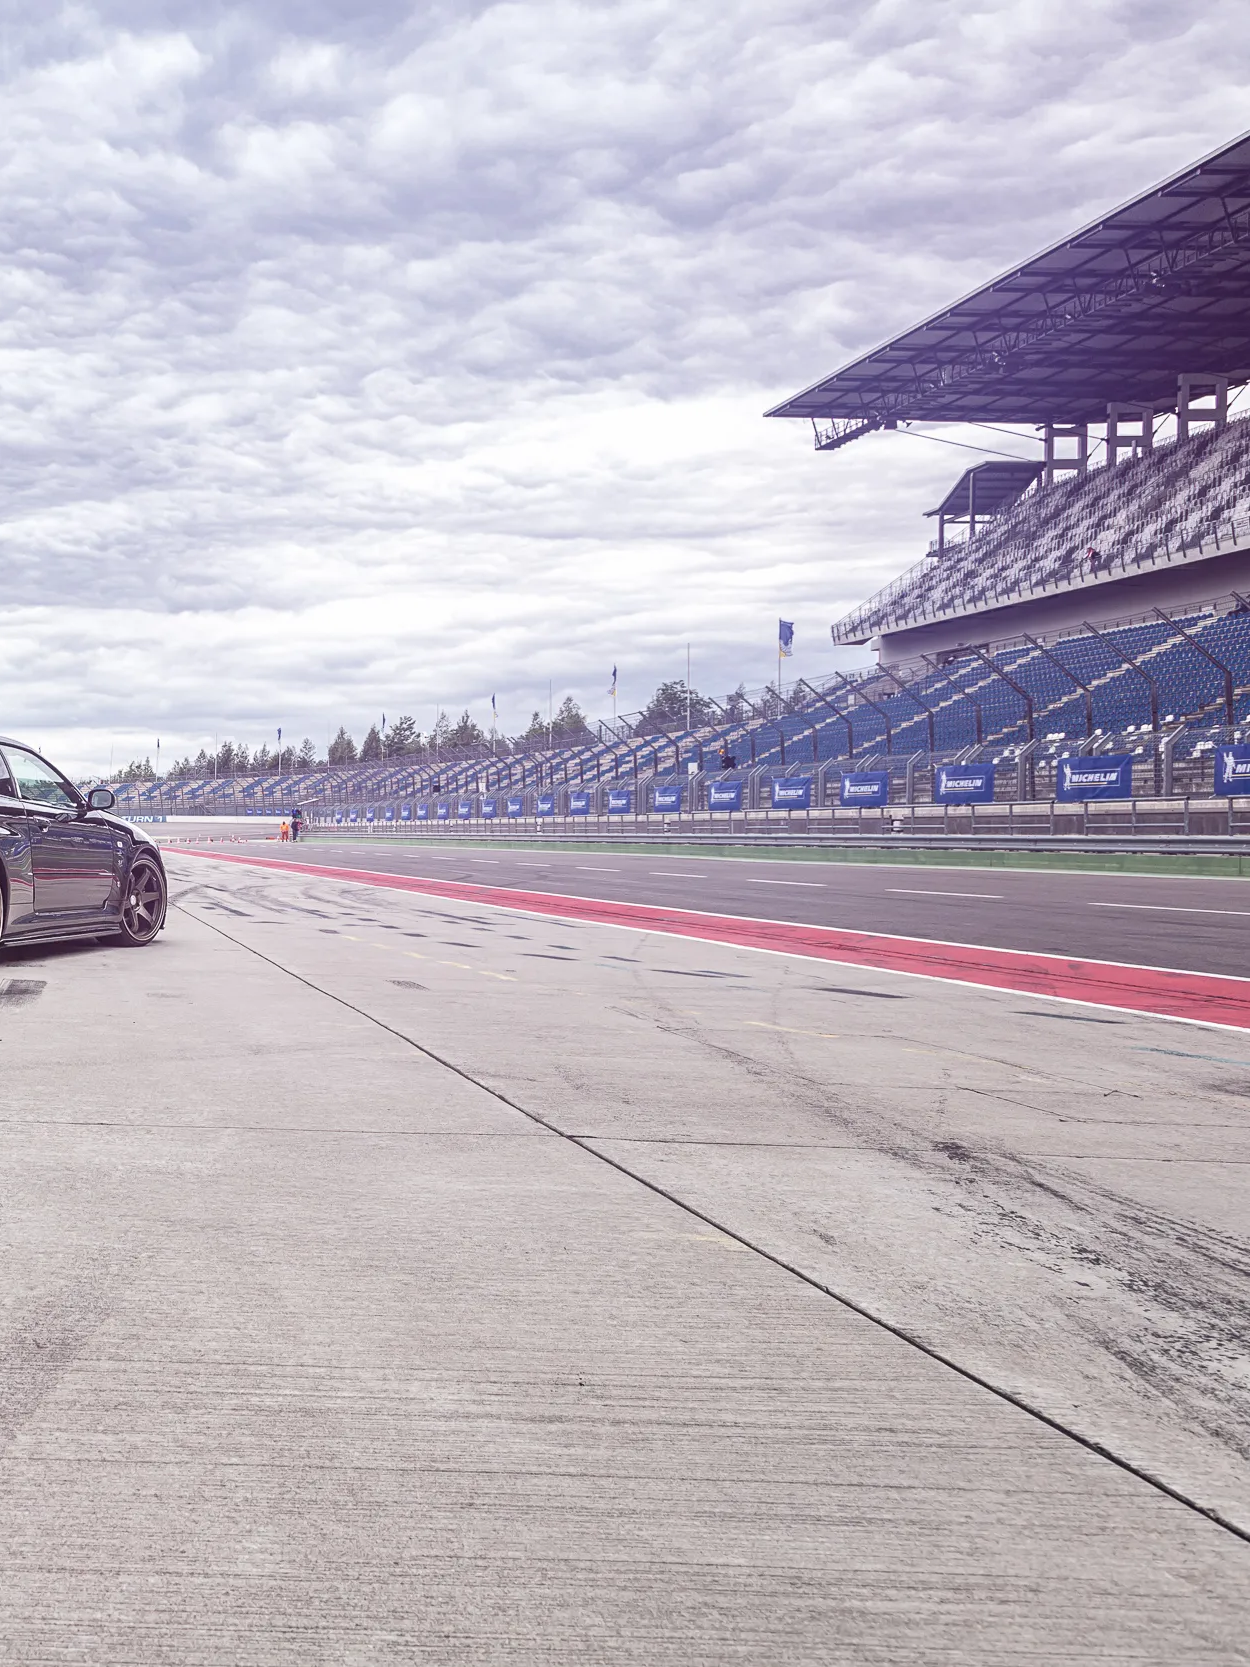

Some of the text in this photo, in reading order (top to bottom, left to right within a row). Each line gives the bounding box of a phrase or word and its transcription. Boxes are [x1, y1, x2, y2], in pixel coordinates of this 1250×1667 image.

[1071, 773, 1117, 782] MICHELIN
[946, 779, 982, 787] MICHELIN
[156, 815, 163, 823] 1
